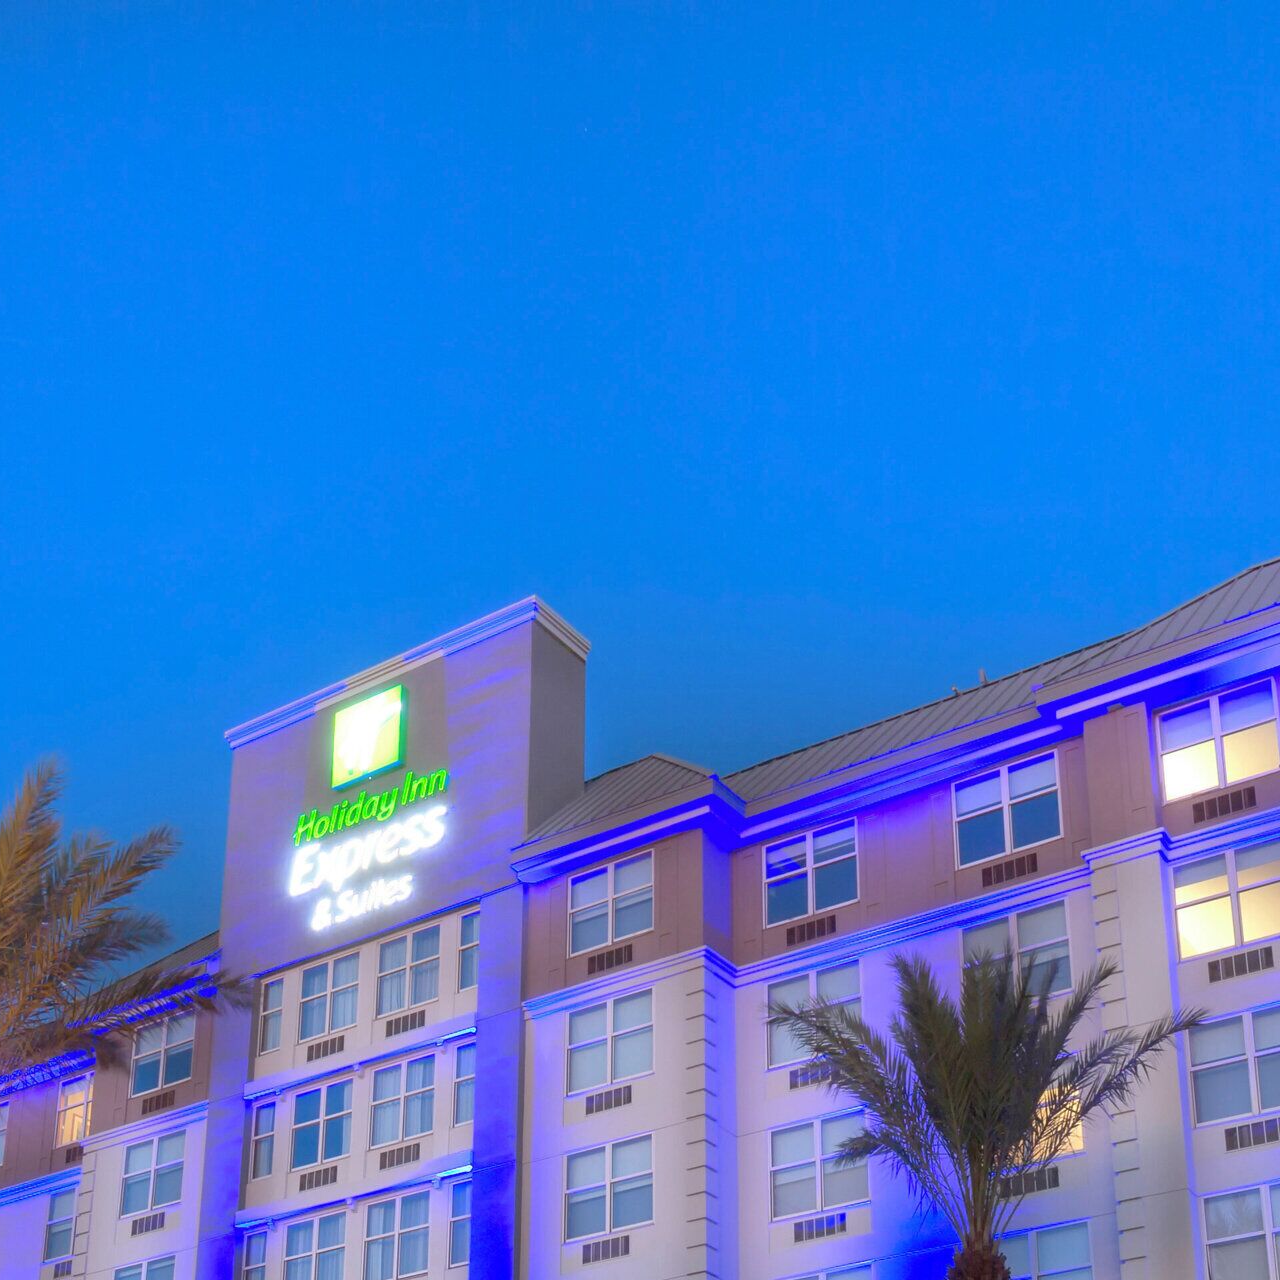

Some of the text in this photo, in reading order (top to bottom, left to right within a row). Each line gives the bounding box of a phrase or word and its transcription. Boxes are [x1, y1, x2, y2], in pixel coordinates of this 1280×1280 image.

[293, 768, 448, 846] Holiday Inn
[288, 805, 447, 897] Express
[311, 875, 413, 931] & Suites
